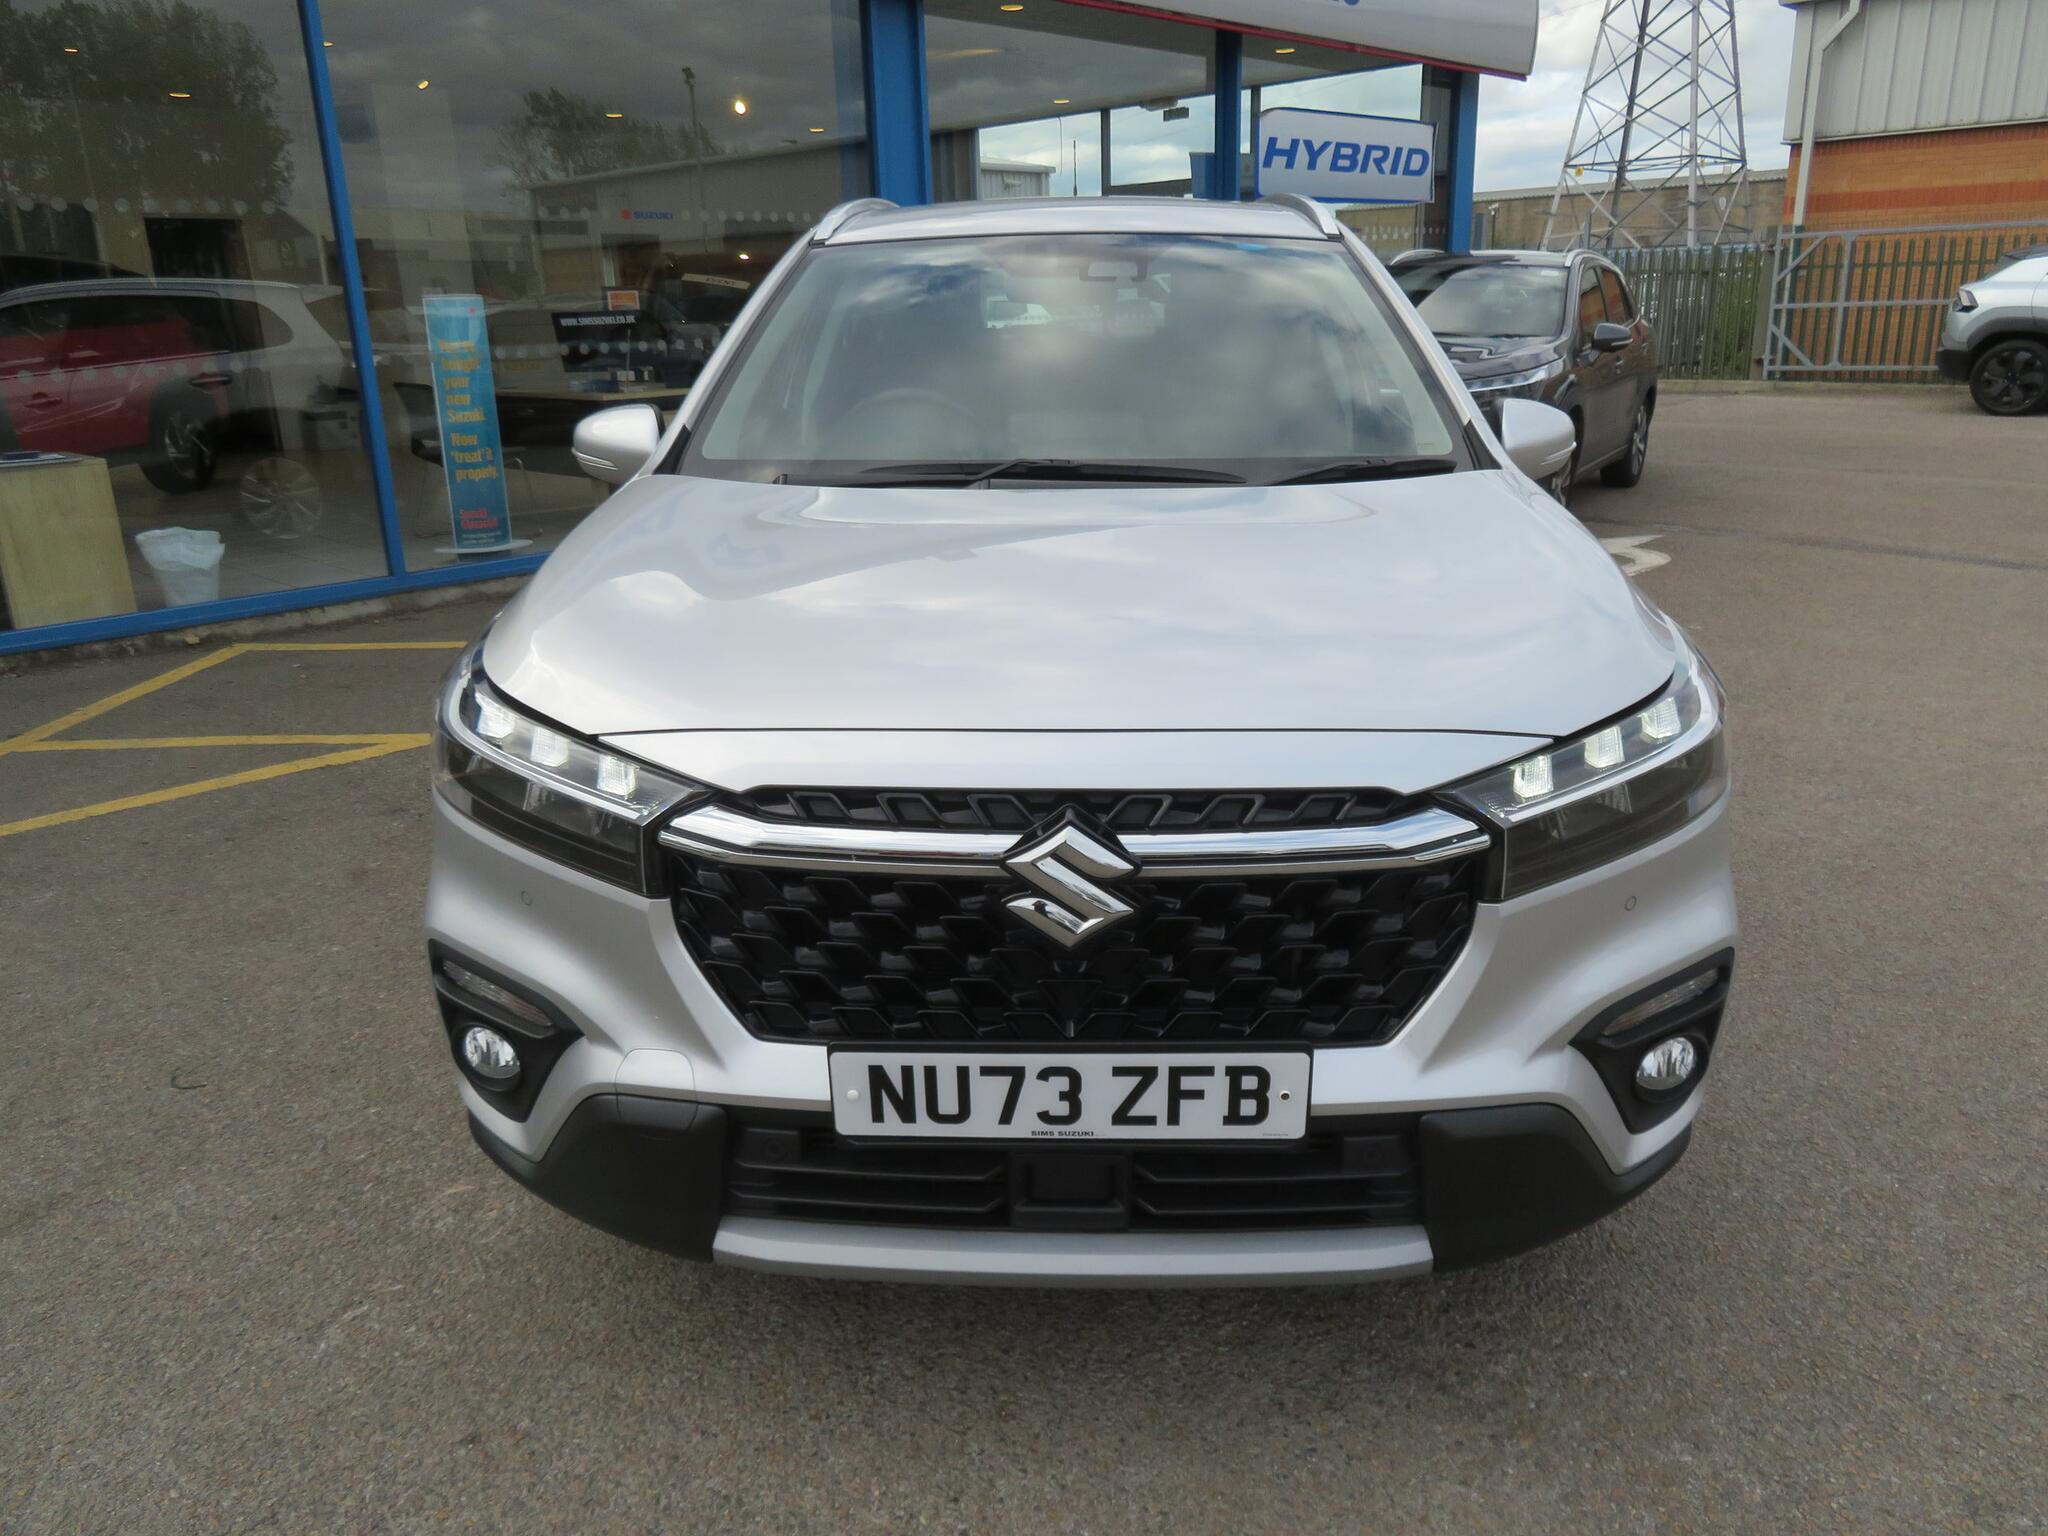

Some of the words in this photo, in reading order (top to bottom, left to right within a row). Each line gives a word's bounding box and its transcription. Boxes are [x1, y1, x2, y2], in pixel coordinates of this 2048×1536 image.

[1262, 136, 1431, 177] HYBRID
[633, 210, 673, 220] SUZUKI
[867, 1064, 1083, 1127] NU73
[1110, 1065, 1272, 1128] ZFB
